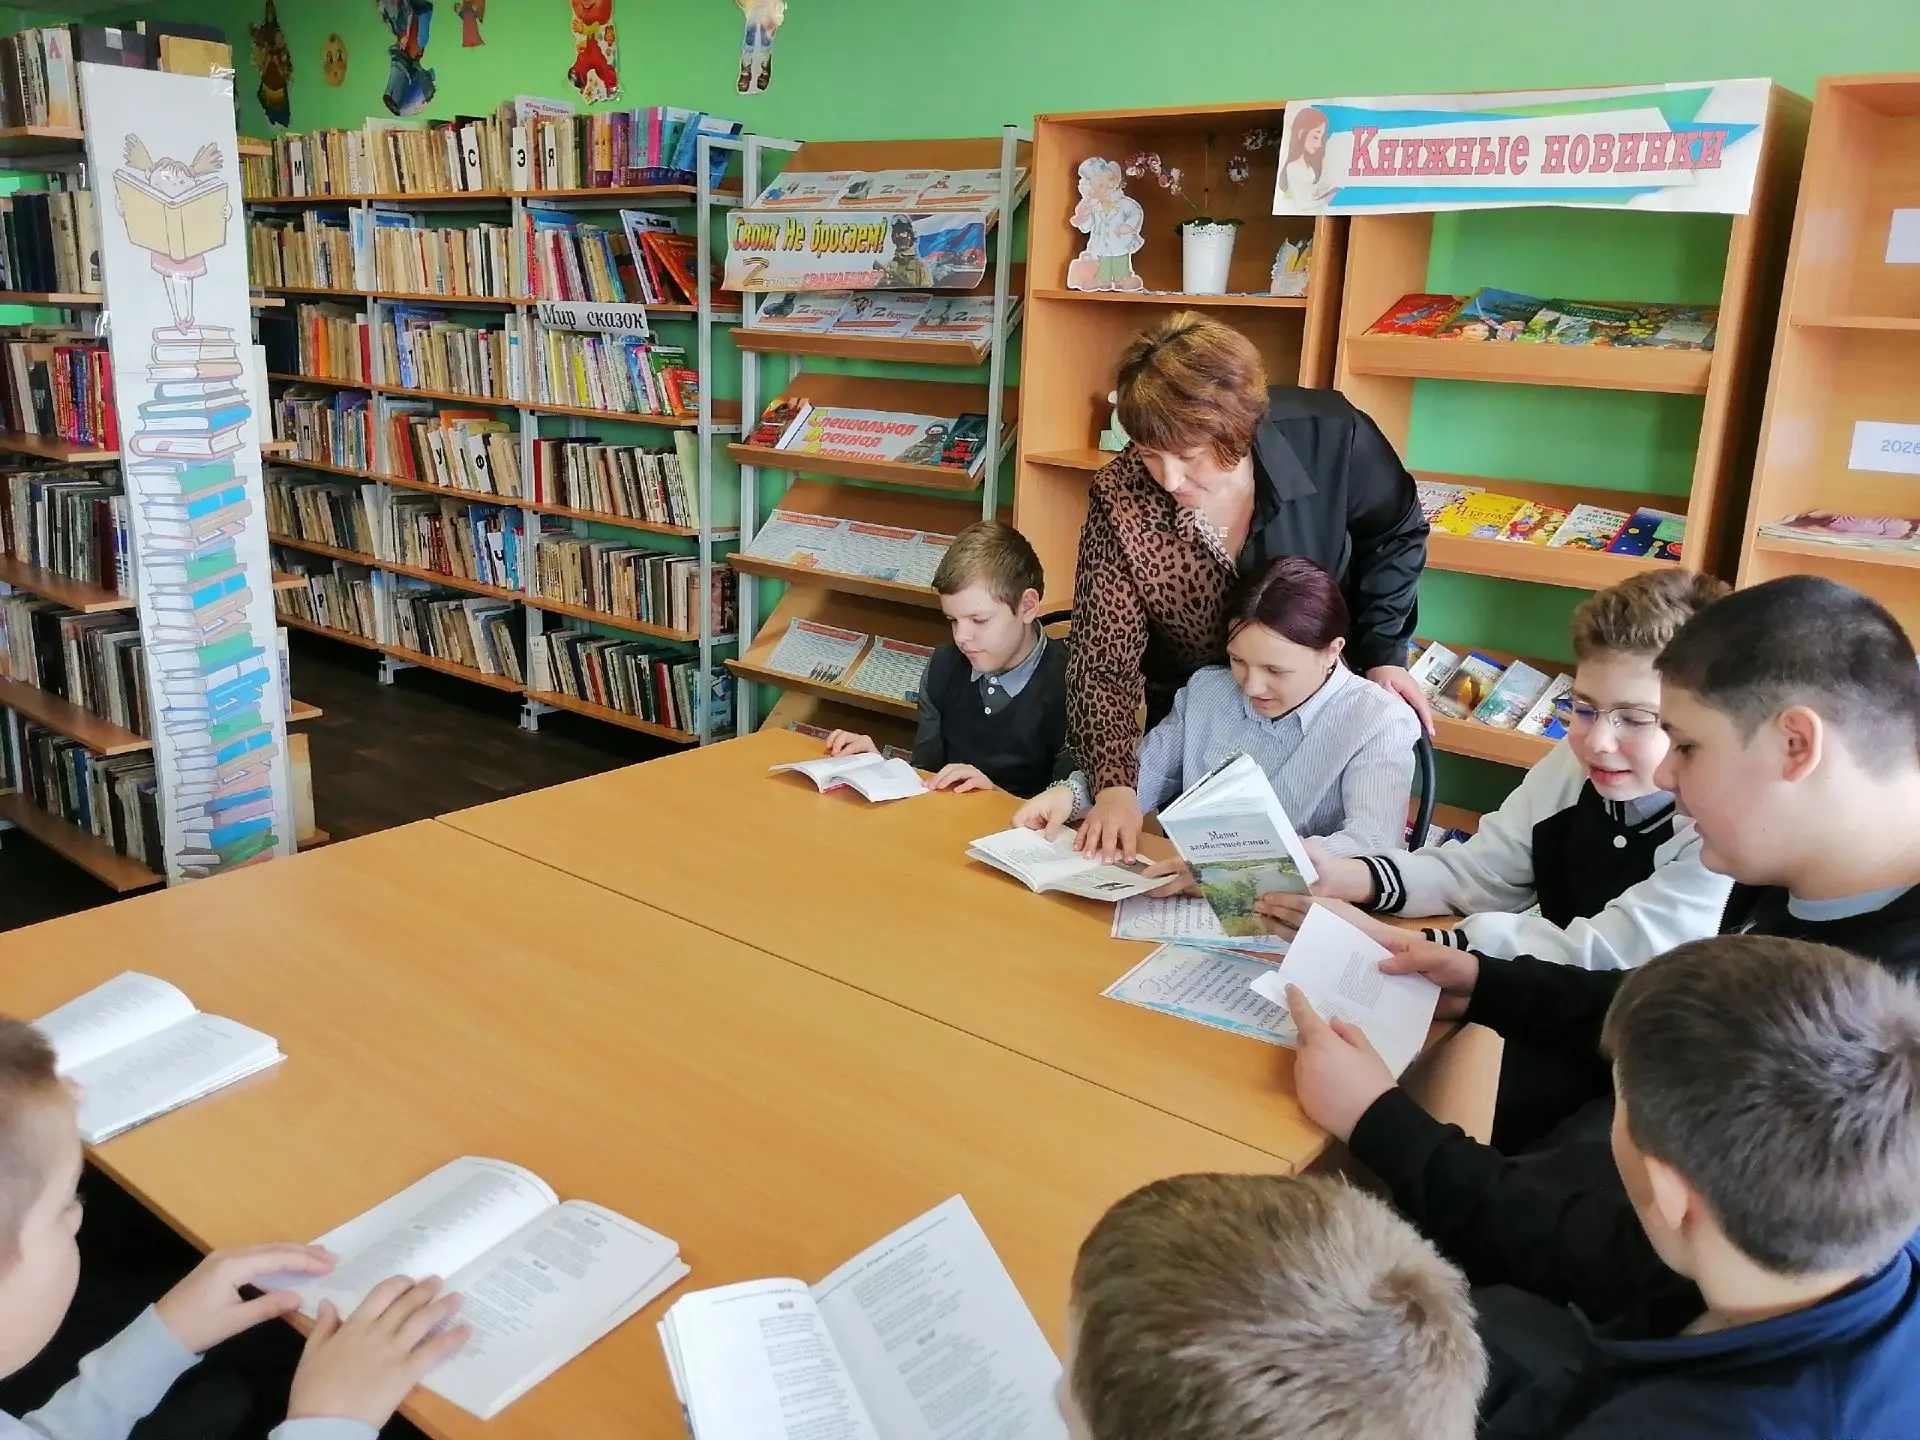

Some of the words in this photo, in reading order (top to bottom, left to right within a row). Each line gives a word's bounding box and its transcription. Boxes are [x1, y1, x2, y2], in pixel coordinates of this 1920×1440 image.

[467, 148, 477, 168] С
[517, 148, 526, 168] Э
[548, 147, 555, 168] Я
[1347, 125, 1530, 177] Книжные
[1540, 127, 1730, 173] новинки
[732, 216, 780, 251] Своих
[782, 216, 806, 251] Не
[810, 216, 888, 259] бросаем!
[541, 303, 576, 329] Мир
[586, 310, 645, 330] сказок
[807, 409, 919, 436] Специальная
[803, 427, 883, 447] Военная
[475, 454, 485, 470] Ф
